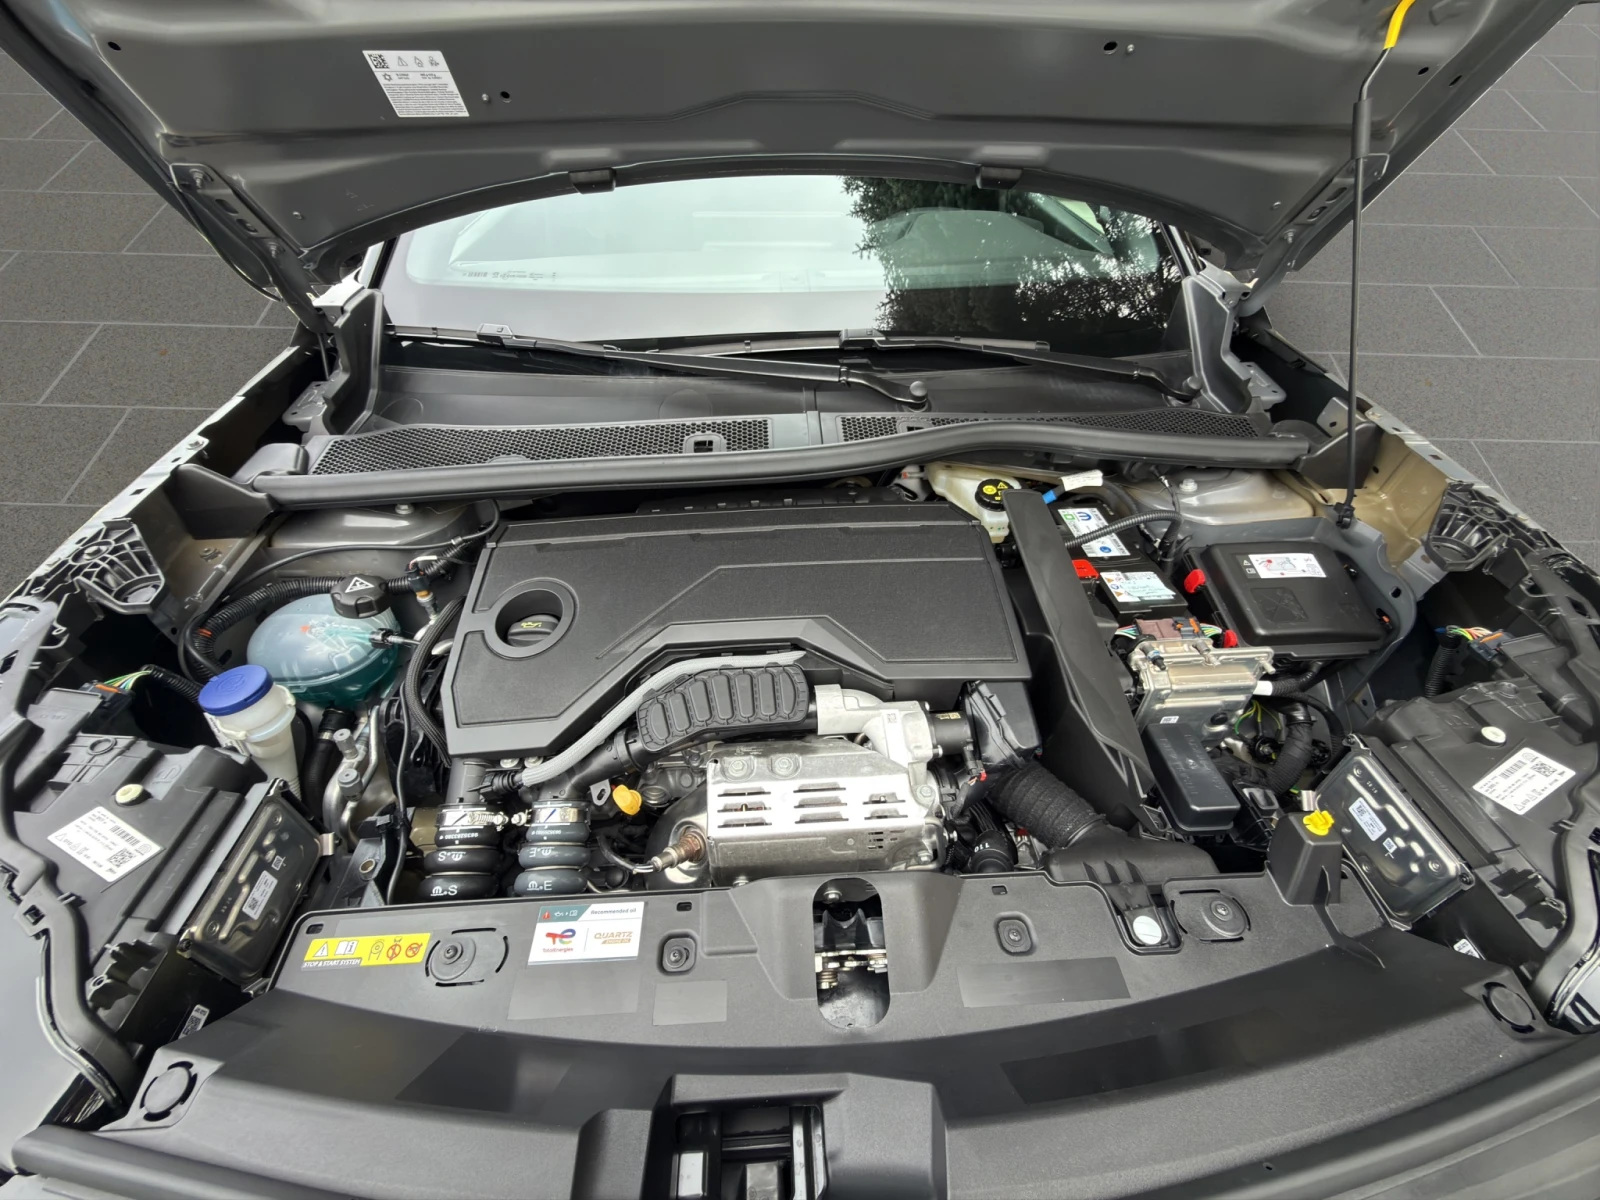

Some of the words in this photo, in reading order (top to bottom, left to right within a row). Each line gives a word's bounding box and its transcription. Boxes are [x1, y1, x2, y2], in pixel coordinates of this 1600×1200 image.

[594, 931, 633, 940] QUARTZ
[323, 959, 340, 967] START
[340, 958, 361, 966] SYSTEM
